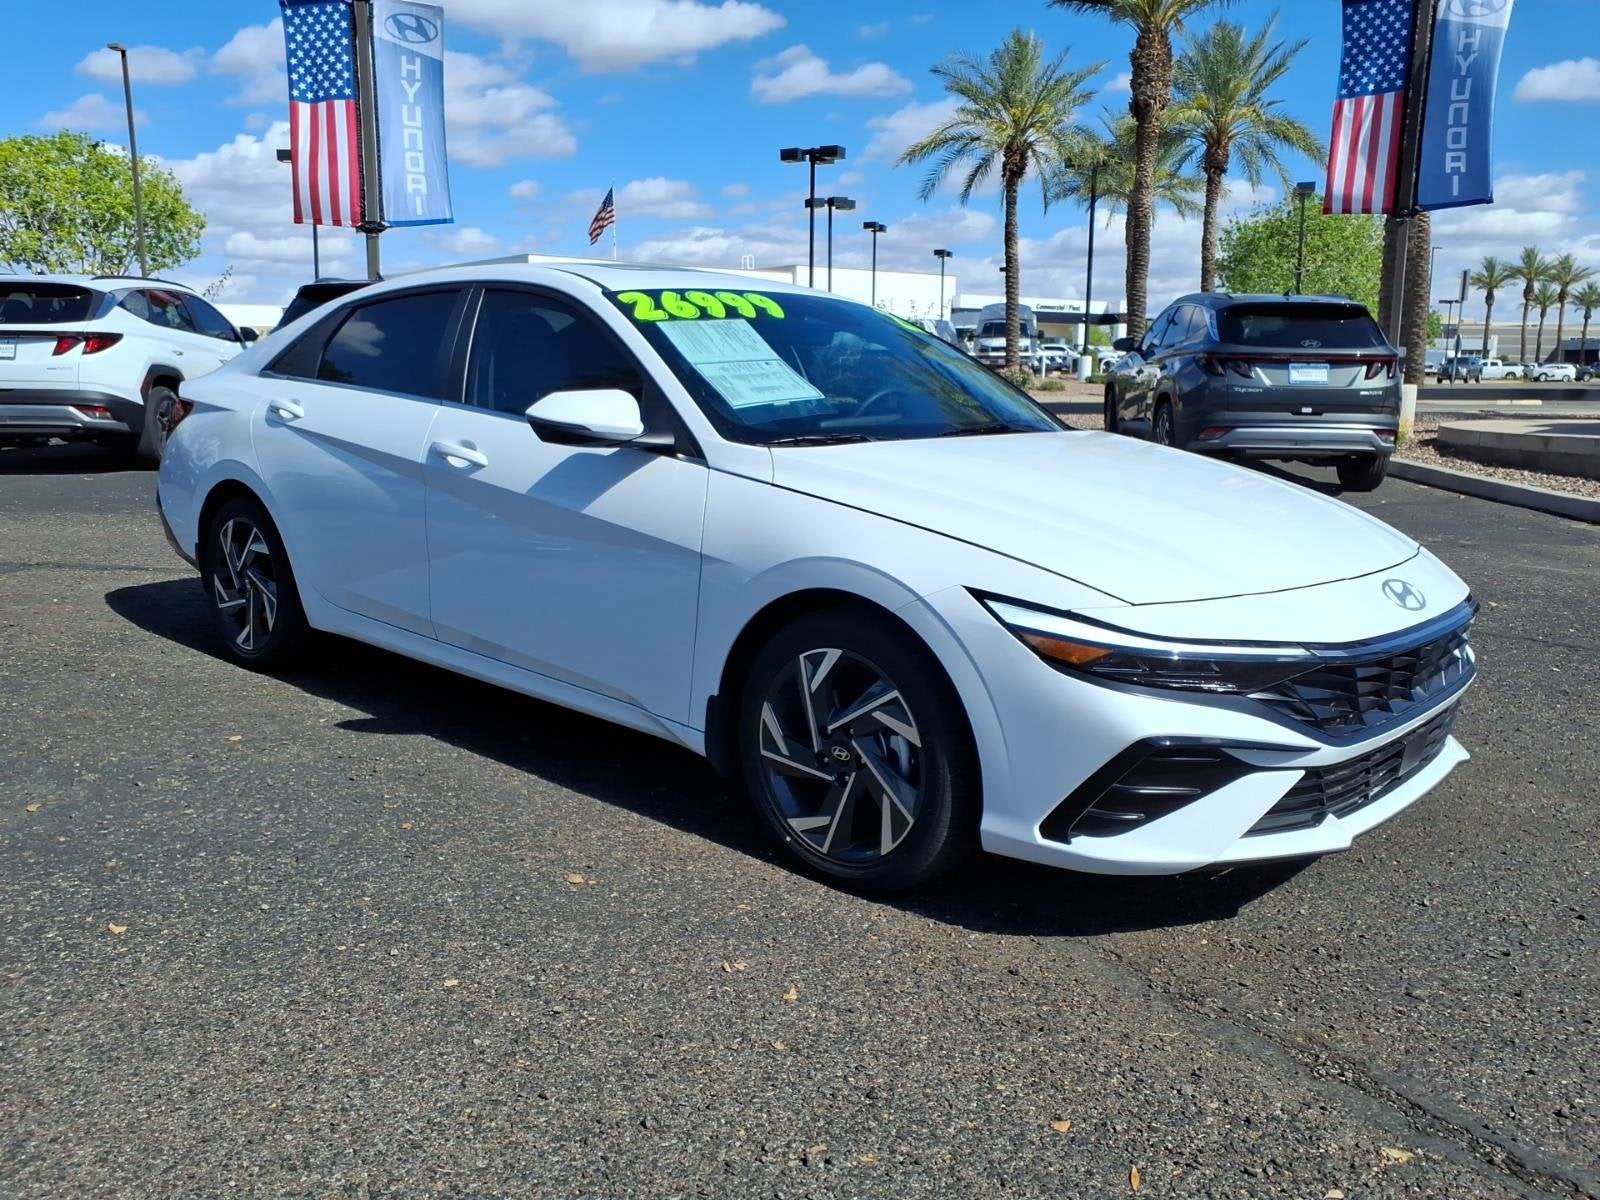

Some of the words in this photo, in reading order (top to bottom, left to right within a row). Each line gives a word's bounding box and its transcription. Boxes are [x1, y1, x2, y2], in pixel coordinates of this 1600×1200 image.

[401, 55, 427, 216] HYUNDAI
[1445, 29, 1481, 196] HYUNDAI
[617, 290, 785, 321] 26999
